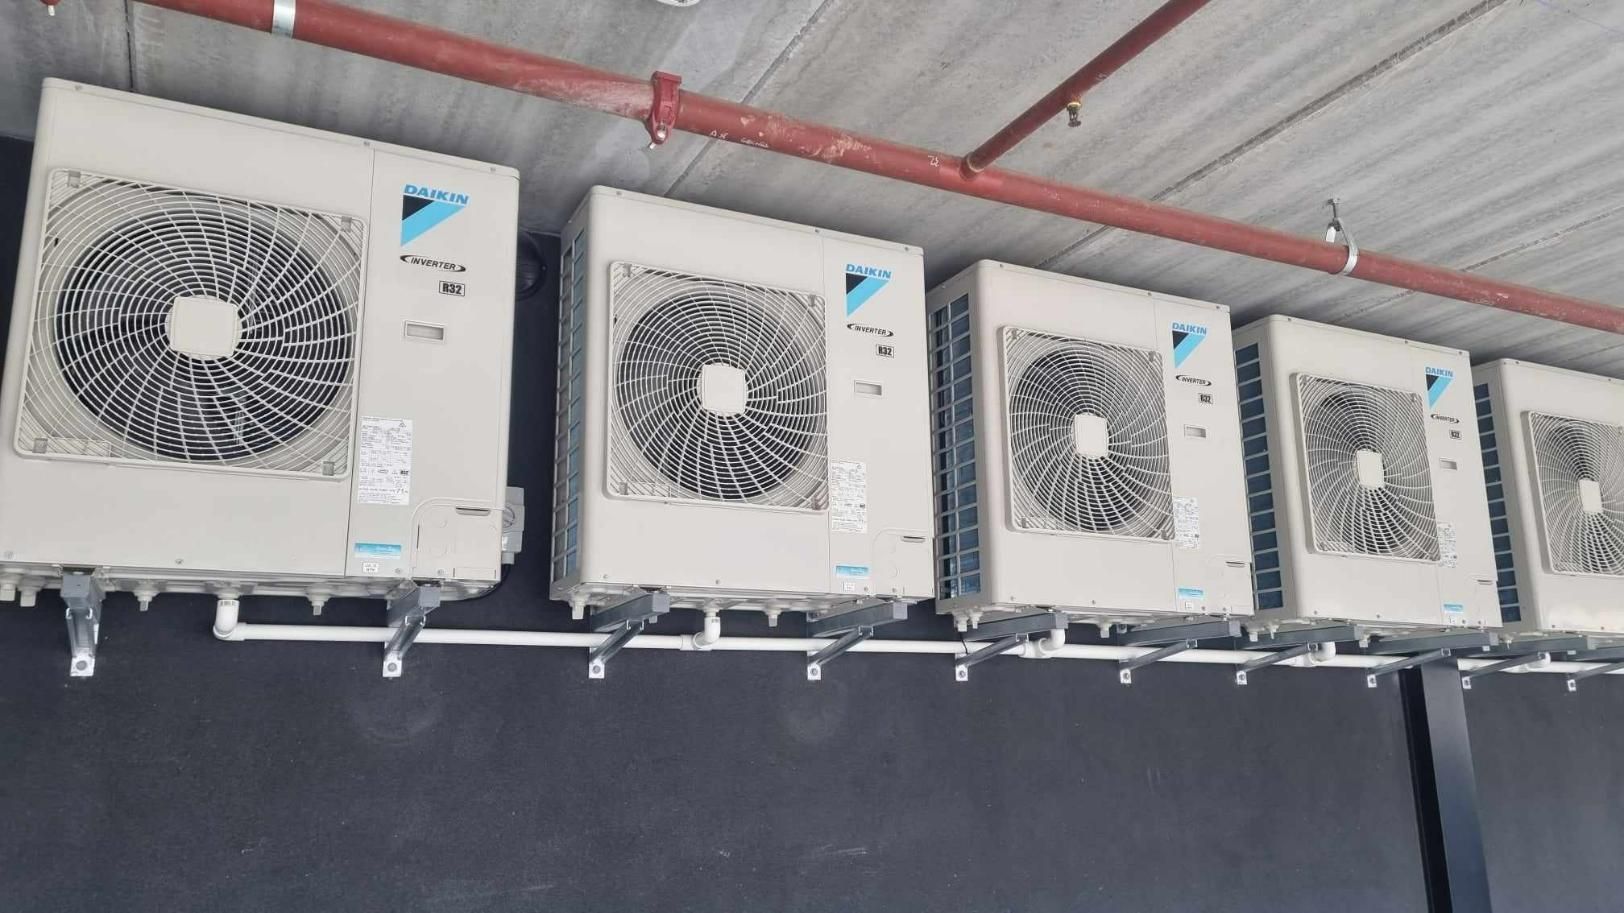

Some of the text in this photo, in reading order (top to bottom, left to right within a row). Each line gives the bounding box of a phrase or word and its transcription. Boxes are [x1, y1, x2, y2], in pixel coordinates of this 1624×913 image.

[404, 184, 469, 205] DAIKIN
[410, 257, 457, 271] INVERTER
[846, 263, 892, 279] DAIKIN
[442, 283, 463, 295] R32
[854, 325, 887, 336] INVERTER
[1172, 322, 1207, 335] DAIKIN
[878, 345, 893, 356] R32
[1425, 366, 1454, 378] DAIKIN
